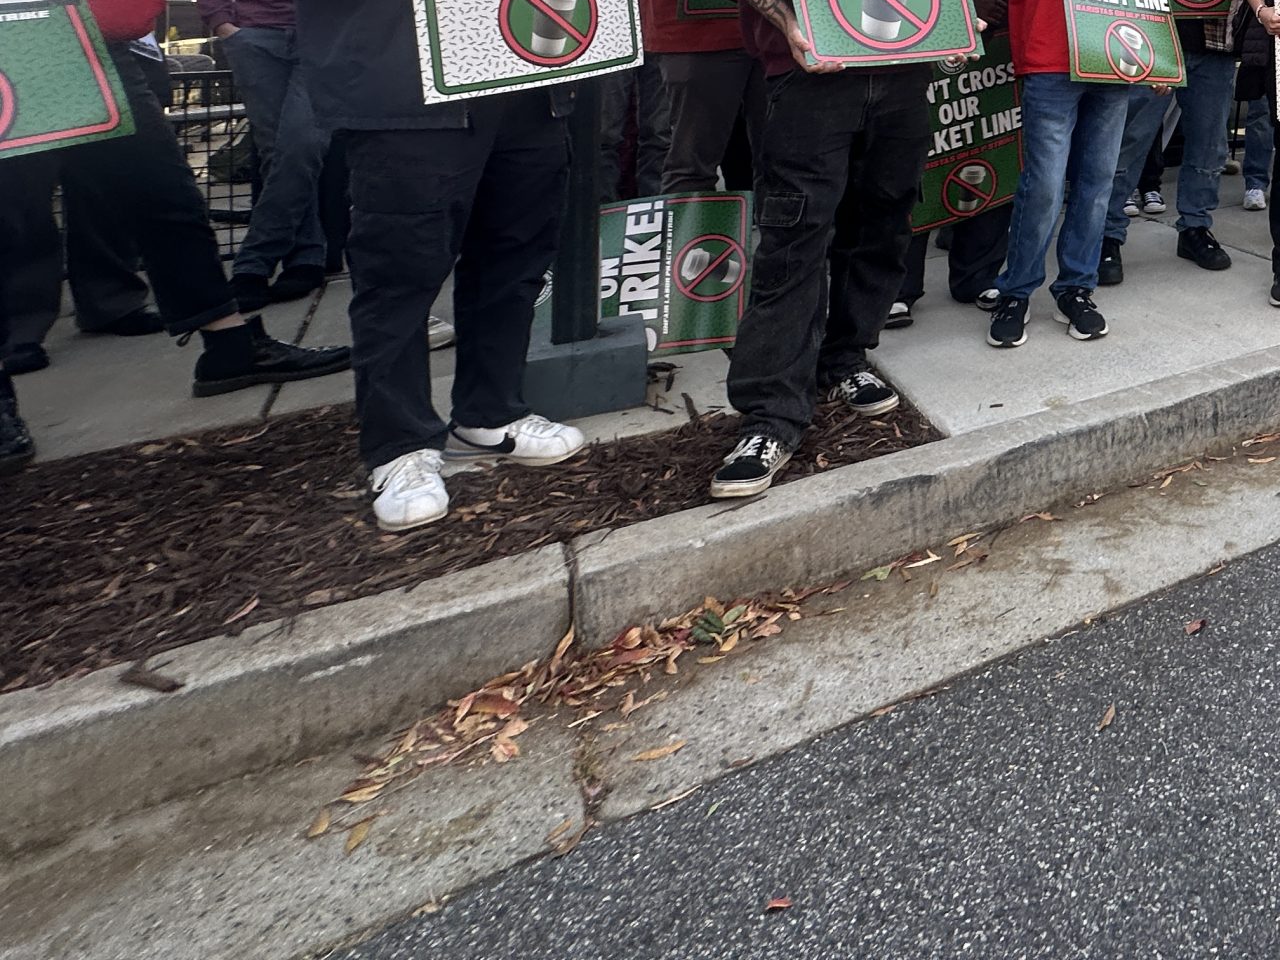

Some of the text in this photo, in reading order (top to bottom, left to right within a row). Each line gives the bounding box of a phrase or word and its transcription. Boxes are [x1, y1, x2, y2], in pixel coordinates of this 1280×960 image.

[957, 61, 1016, 95] CROSS
[938, 96, 981, 125] OUR
[927, 106, 1022, 157] KET LINE
